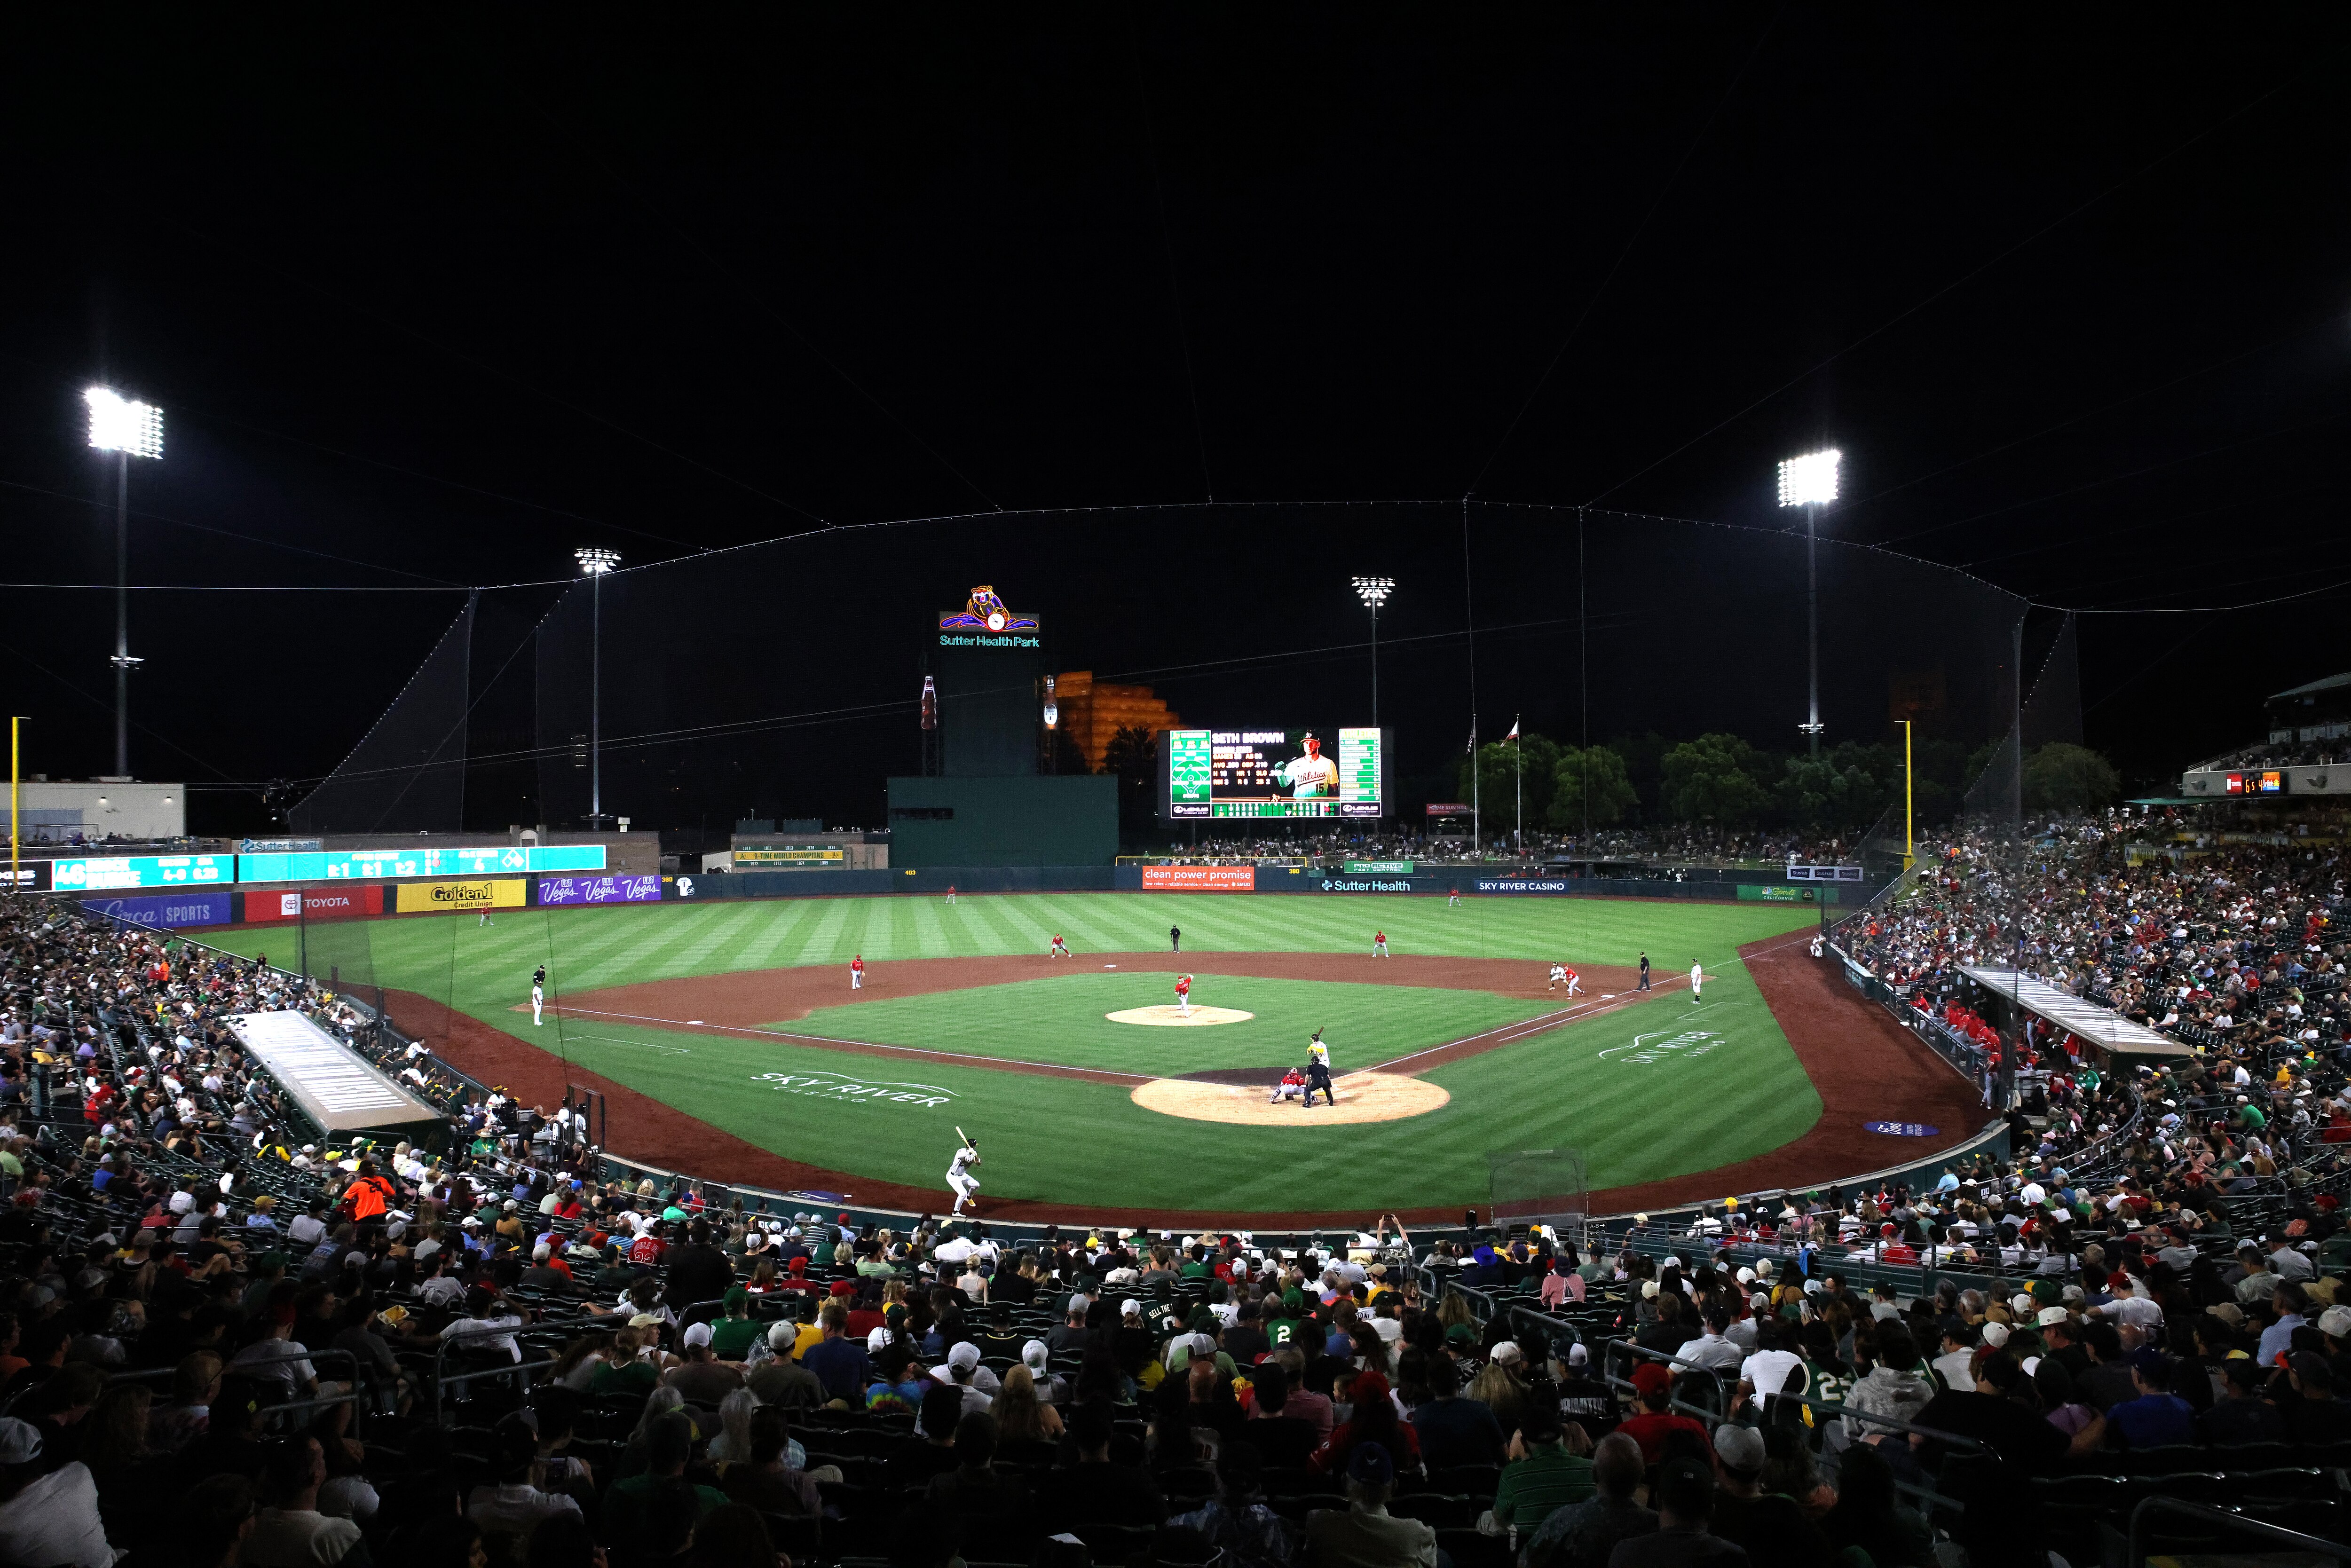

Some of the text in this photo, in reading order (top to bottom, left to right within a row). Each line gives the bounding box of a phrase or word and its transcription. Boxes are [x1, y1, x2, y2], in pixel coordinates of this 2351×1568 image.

[940, 635, 1039, 647] Sutter Health Park
[1212, 733, 1240, 744] SETH
[1242, 732, 1284, 743] BROWN
[1316, 783, 1324, 793] 15
[2246, 779, 2250, 793] 6
[256, 840, 320, 851] Sutter Health
[56, 864, 86, 885] 46
[1145, 869, 1251, 881] clean power promise
[539, 881, 579, 903] Vegas
[581, 879, 619, 901] Vegas
[622, 878, 660, 900] Vegas
[1334, 881, 1410, 891] Sutter Health
[1772, 887, 1796, 896] Sports
[305, 897, 350, 908] TOYOTA
[104, 900, 210, 922] Circa SPORTS
[1620, 1031, 1722, 1064] SKY RIVER
[749, 1073, 950, 1107] SKY RIVER
[773, 1086, 867, 1103] CASINO
[1878, 1122, 1902, 1135] Ford
[1149, 1307, 1163, 1319] SELL
[1160, 1304, 1171, 1314] THE
[1277, 1325, 1290, 1343] 2
